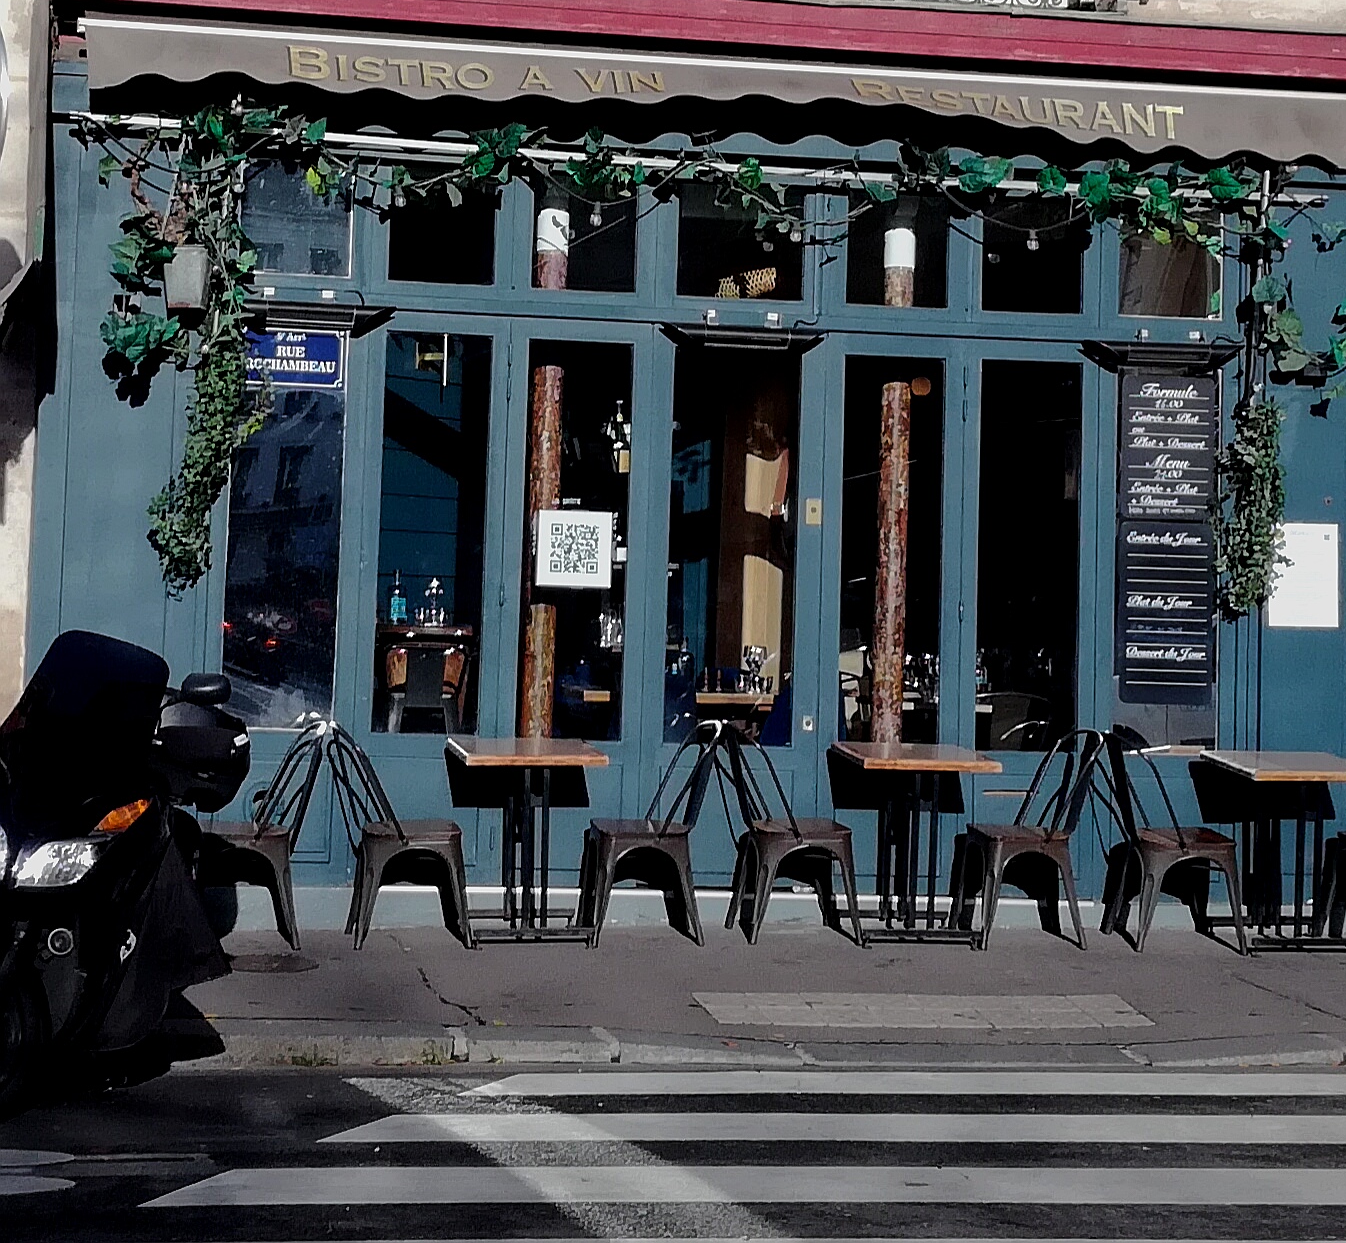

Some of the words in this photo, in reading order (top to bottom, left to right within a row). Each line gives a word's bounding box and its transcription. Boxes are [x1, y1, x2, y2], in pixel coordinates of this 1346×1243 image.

[286, 45, 495, 90] BISTRO
[518, 65, 553, 91] A
[573, 67, 665, 95] VIN
[851, 79, 1184, 140] RESTAURANT
[276, 345, 306, 358] RUE
[1140, 383, 1198, 398] Formule
[1145, 454, 1190, 468] Menu
[1160, 532, 1173, 544] du
[1172, 532, 1201, 547] Jour
[1151, 596, 1165, 608] du
[1163, 597, 1192, 610] Jour
[1164, 647, 1178, 658] du
[1176, 648, 1205, 662] Jour
